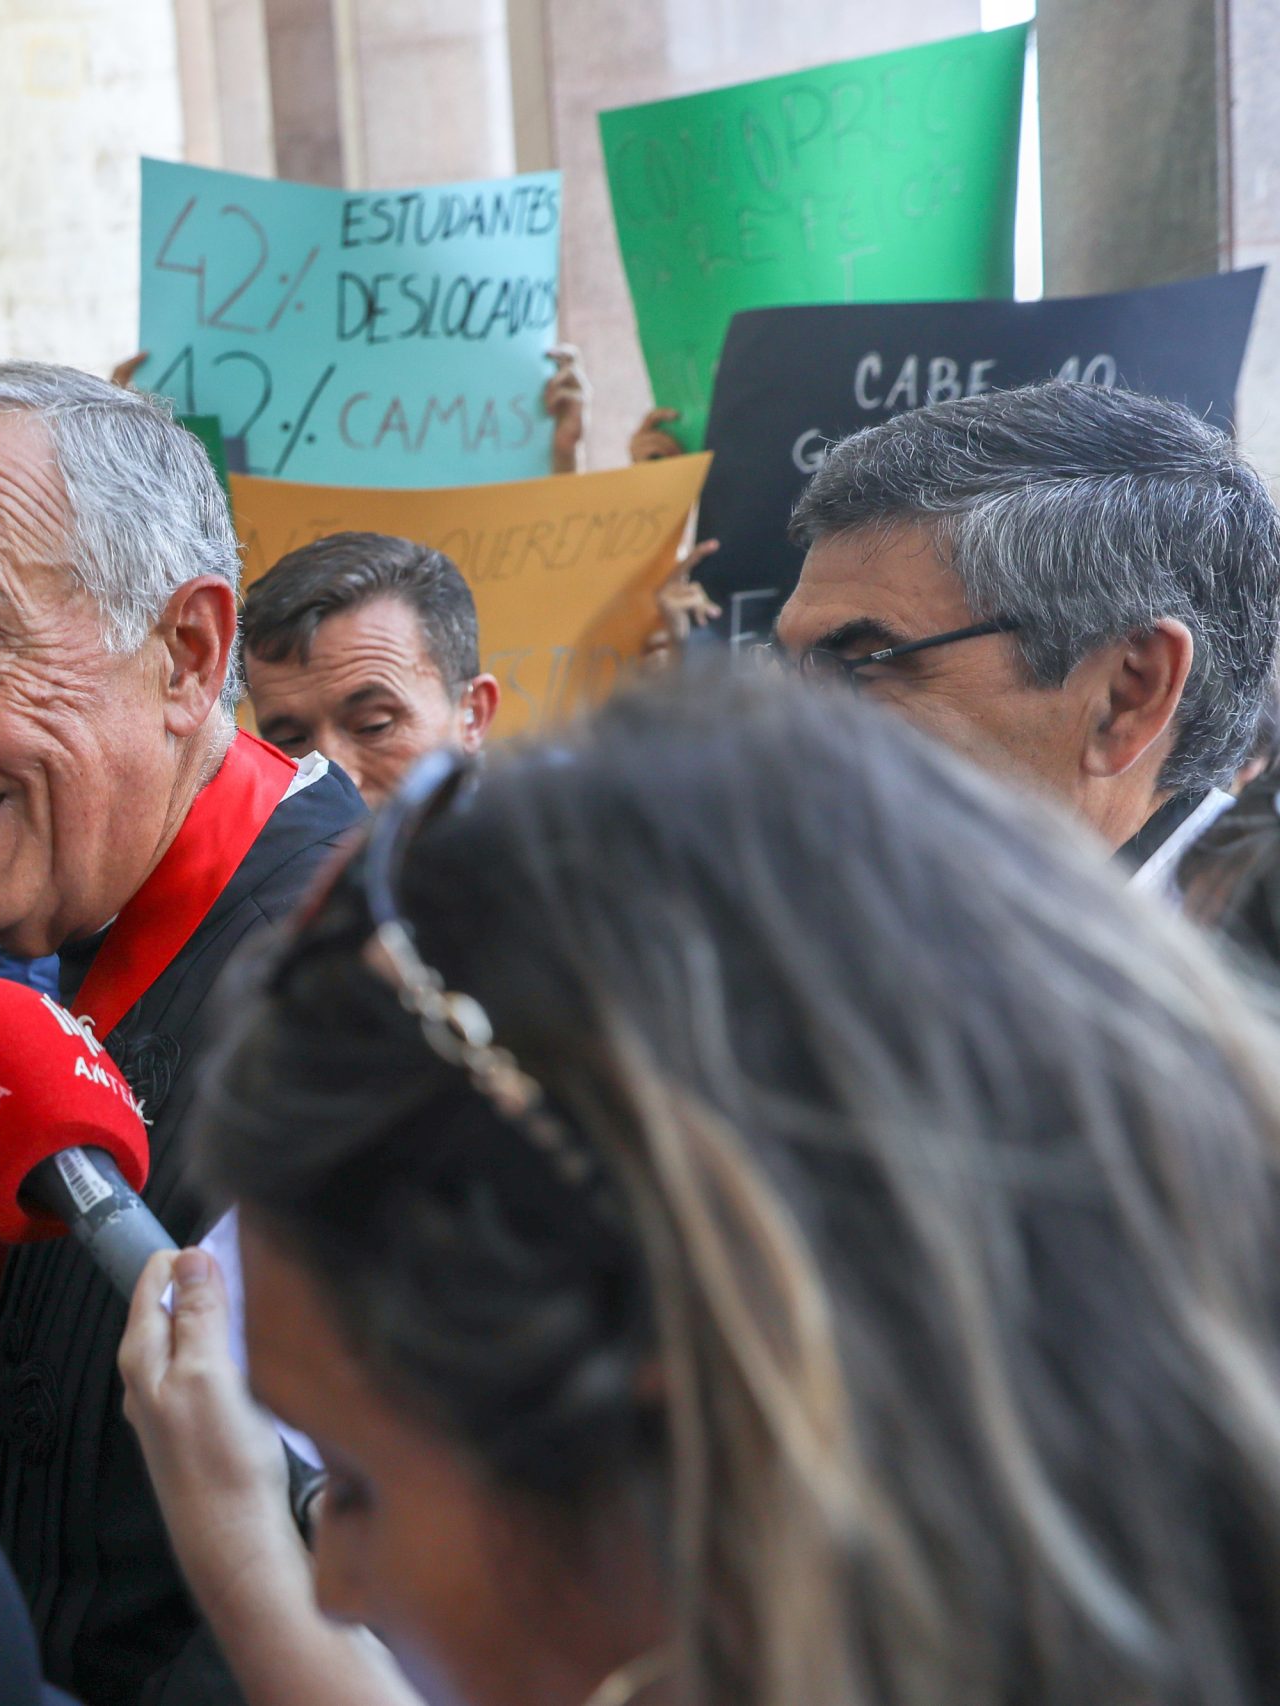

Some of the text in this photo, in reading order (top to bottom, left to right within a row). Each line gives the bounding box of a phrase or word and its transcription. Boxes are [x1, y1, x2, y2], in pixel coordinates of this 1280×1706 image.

[154, 184, 559, 335] 42% ESTUDANTES
[336, 270, 557, 346] DESLOCADOS
[853, 351, 997, 411] CABE
[337, 391, 535, 455] CAMAS
